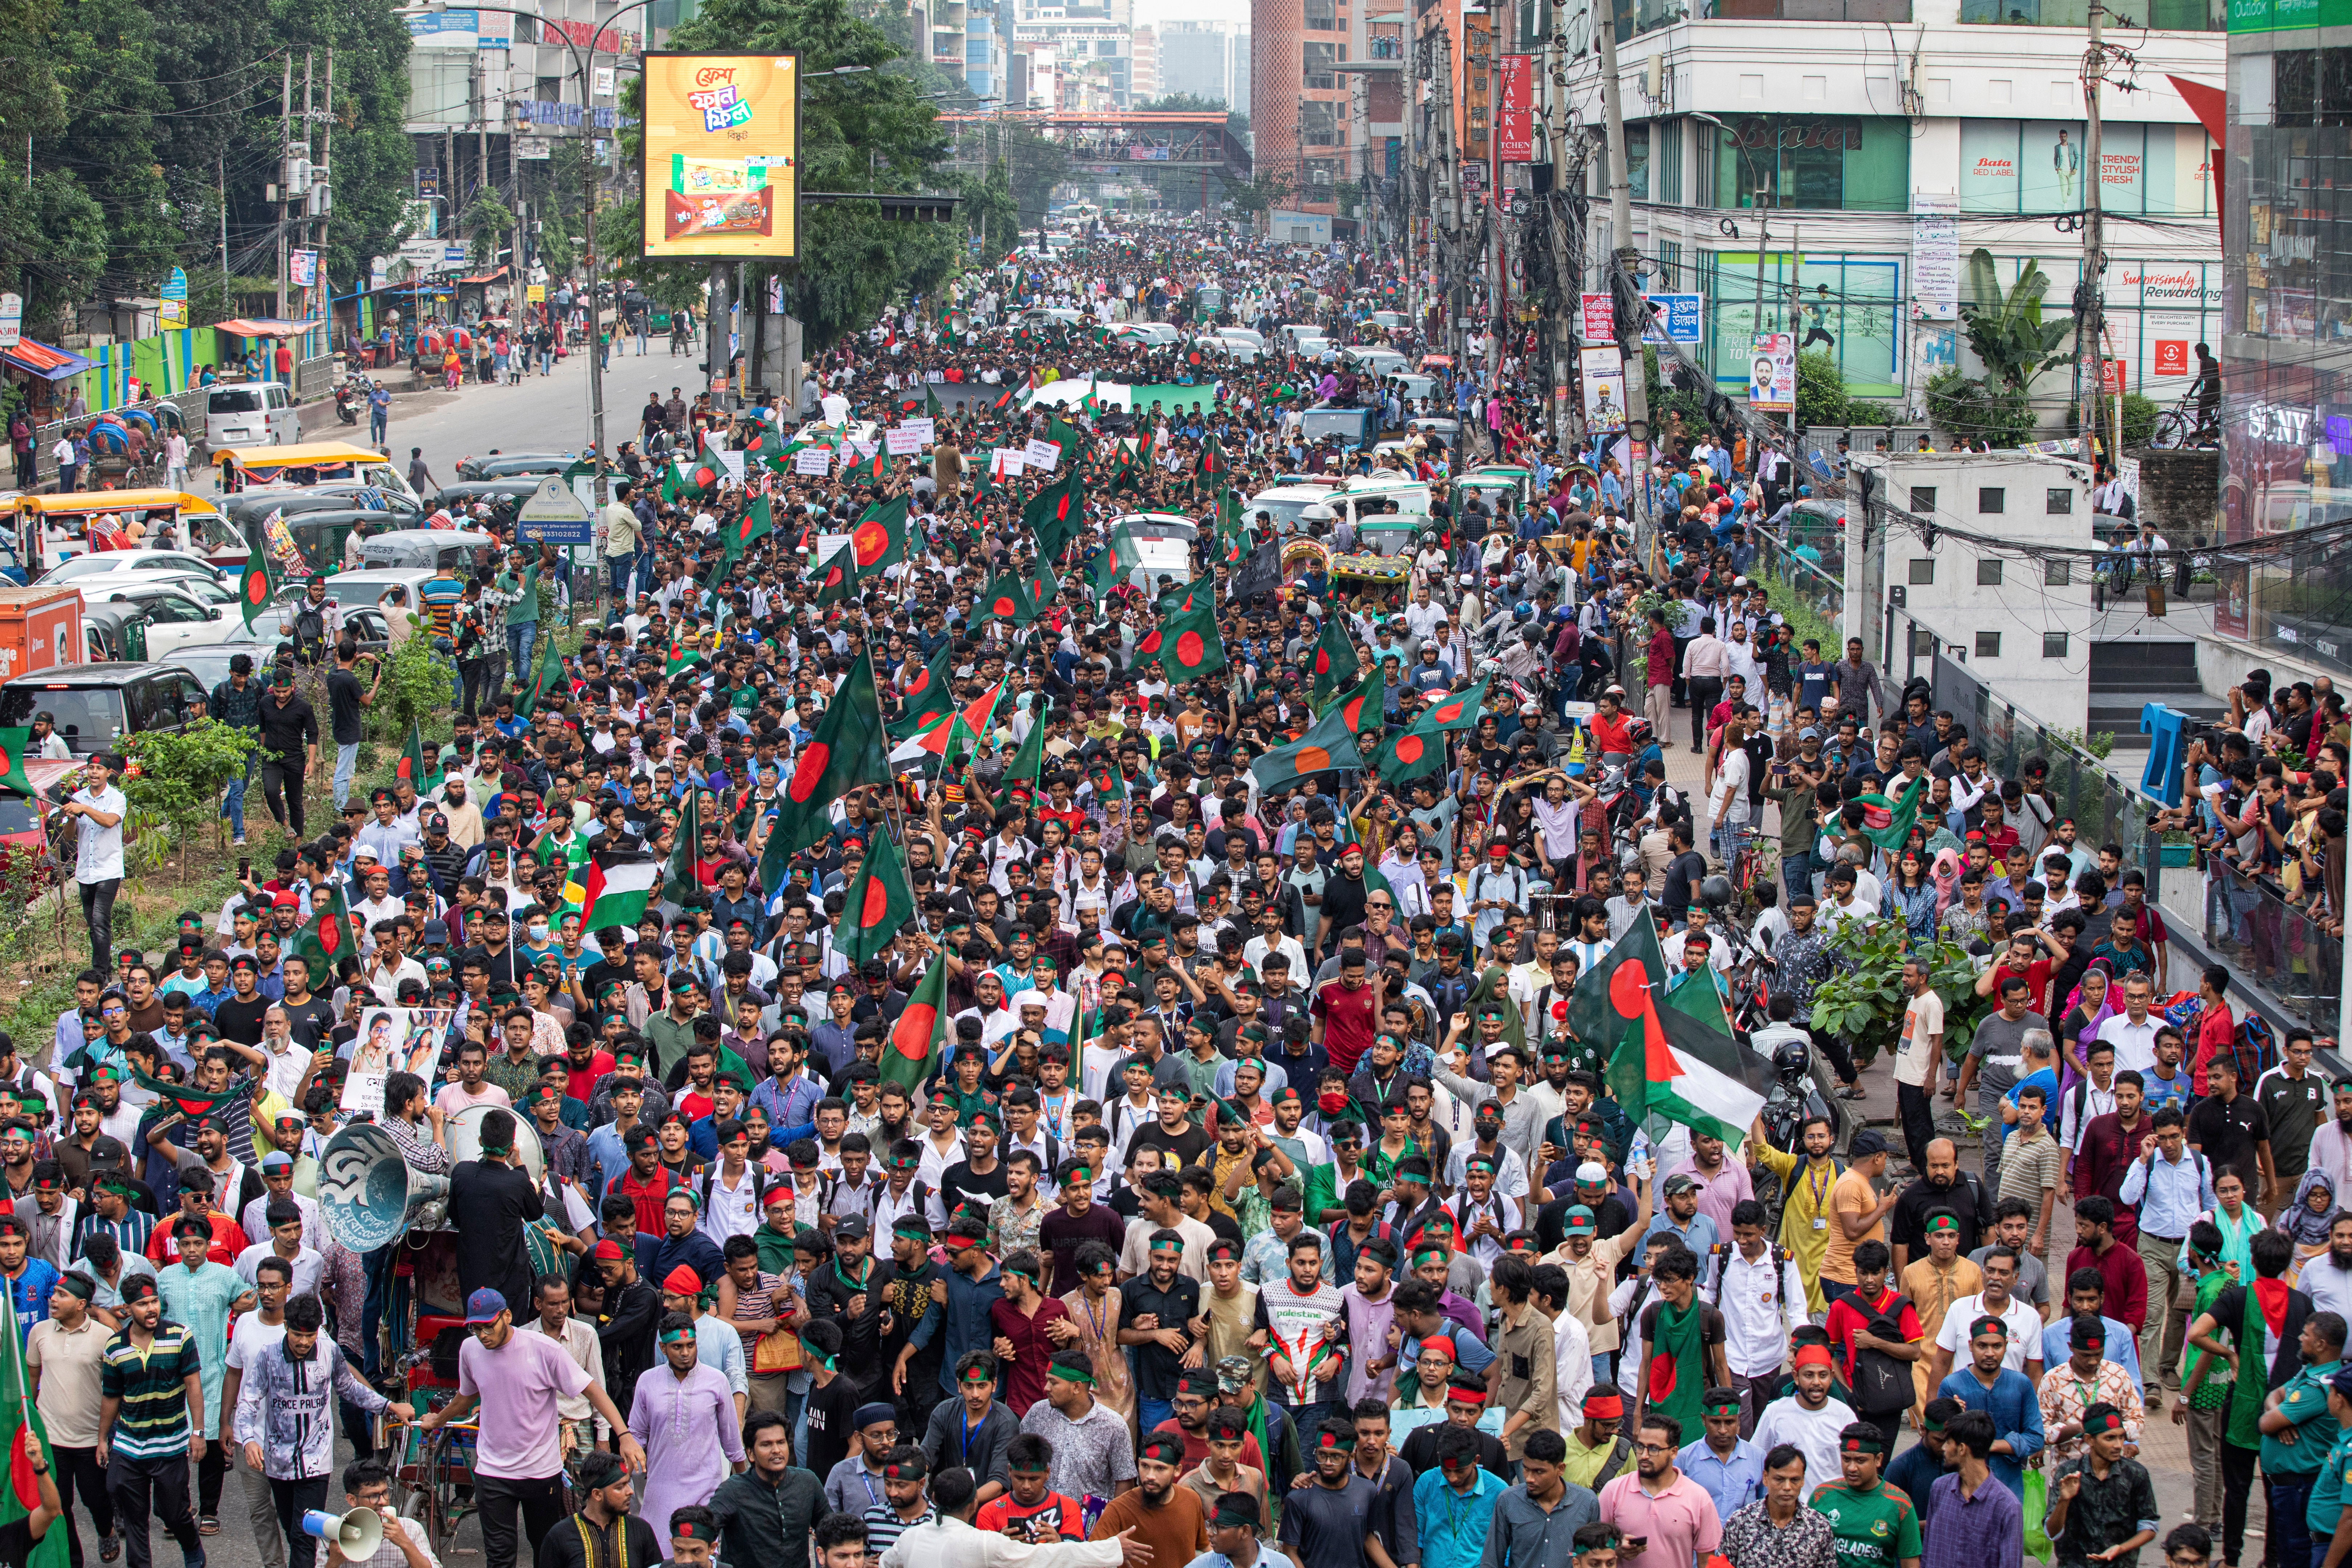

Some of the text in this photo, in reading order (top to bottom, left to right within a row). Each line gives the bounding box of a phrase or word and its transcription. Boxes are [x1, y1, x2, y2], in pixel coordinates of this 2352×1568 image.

[696, 67, 737, 87] ফ্রেশ
[689, 87, 735, 110] ফান
[706, 100, 751, 131] ফিল
[727, 131, 748, 141] বিস্কুট
[1724, 117, 1860, 150] Bata
[1977, 158, 2011, 167] Bata
[2102, 155, 2140, 164] TRENDY
[2102, 165, 2139, 174] STYLISH
[2102, 175, 2132, 184] FRESH
[2123, 271, 2196, 297] Surprisingly
[2145, 286, 2223, 301] Rewarding
[1586, 297, 1613, 310] মেডিকে
[1729, 348, 1744, 359] TO
[2248, 403, 2308, 444] SONY
[2278, 625, 2297, 643] BRAVIA
[2316, 640, 2338, 658] SONY
[272, 1398, 297, 1409] PEACE
